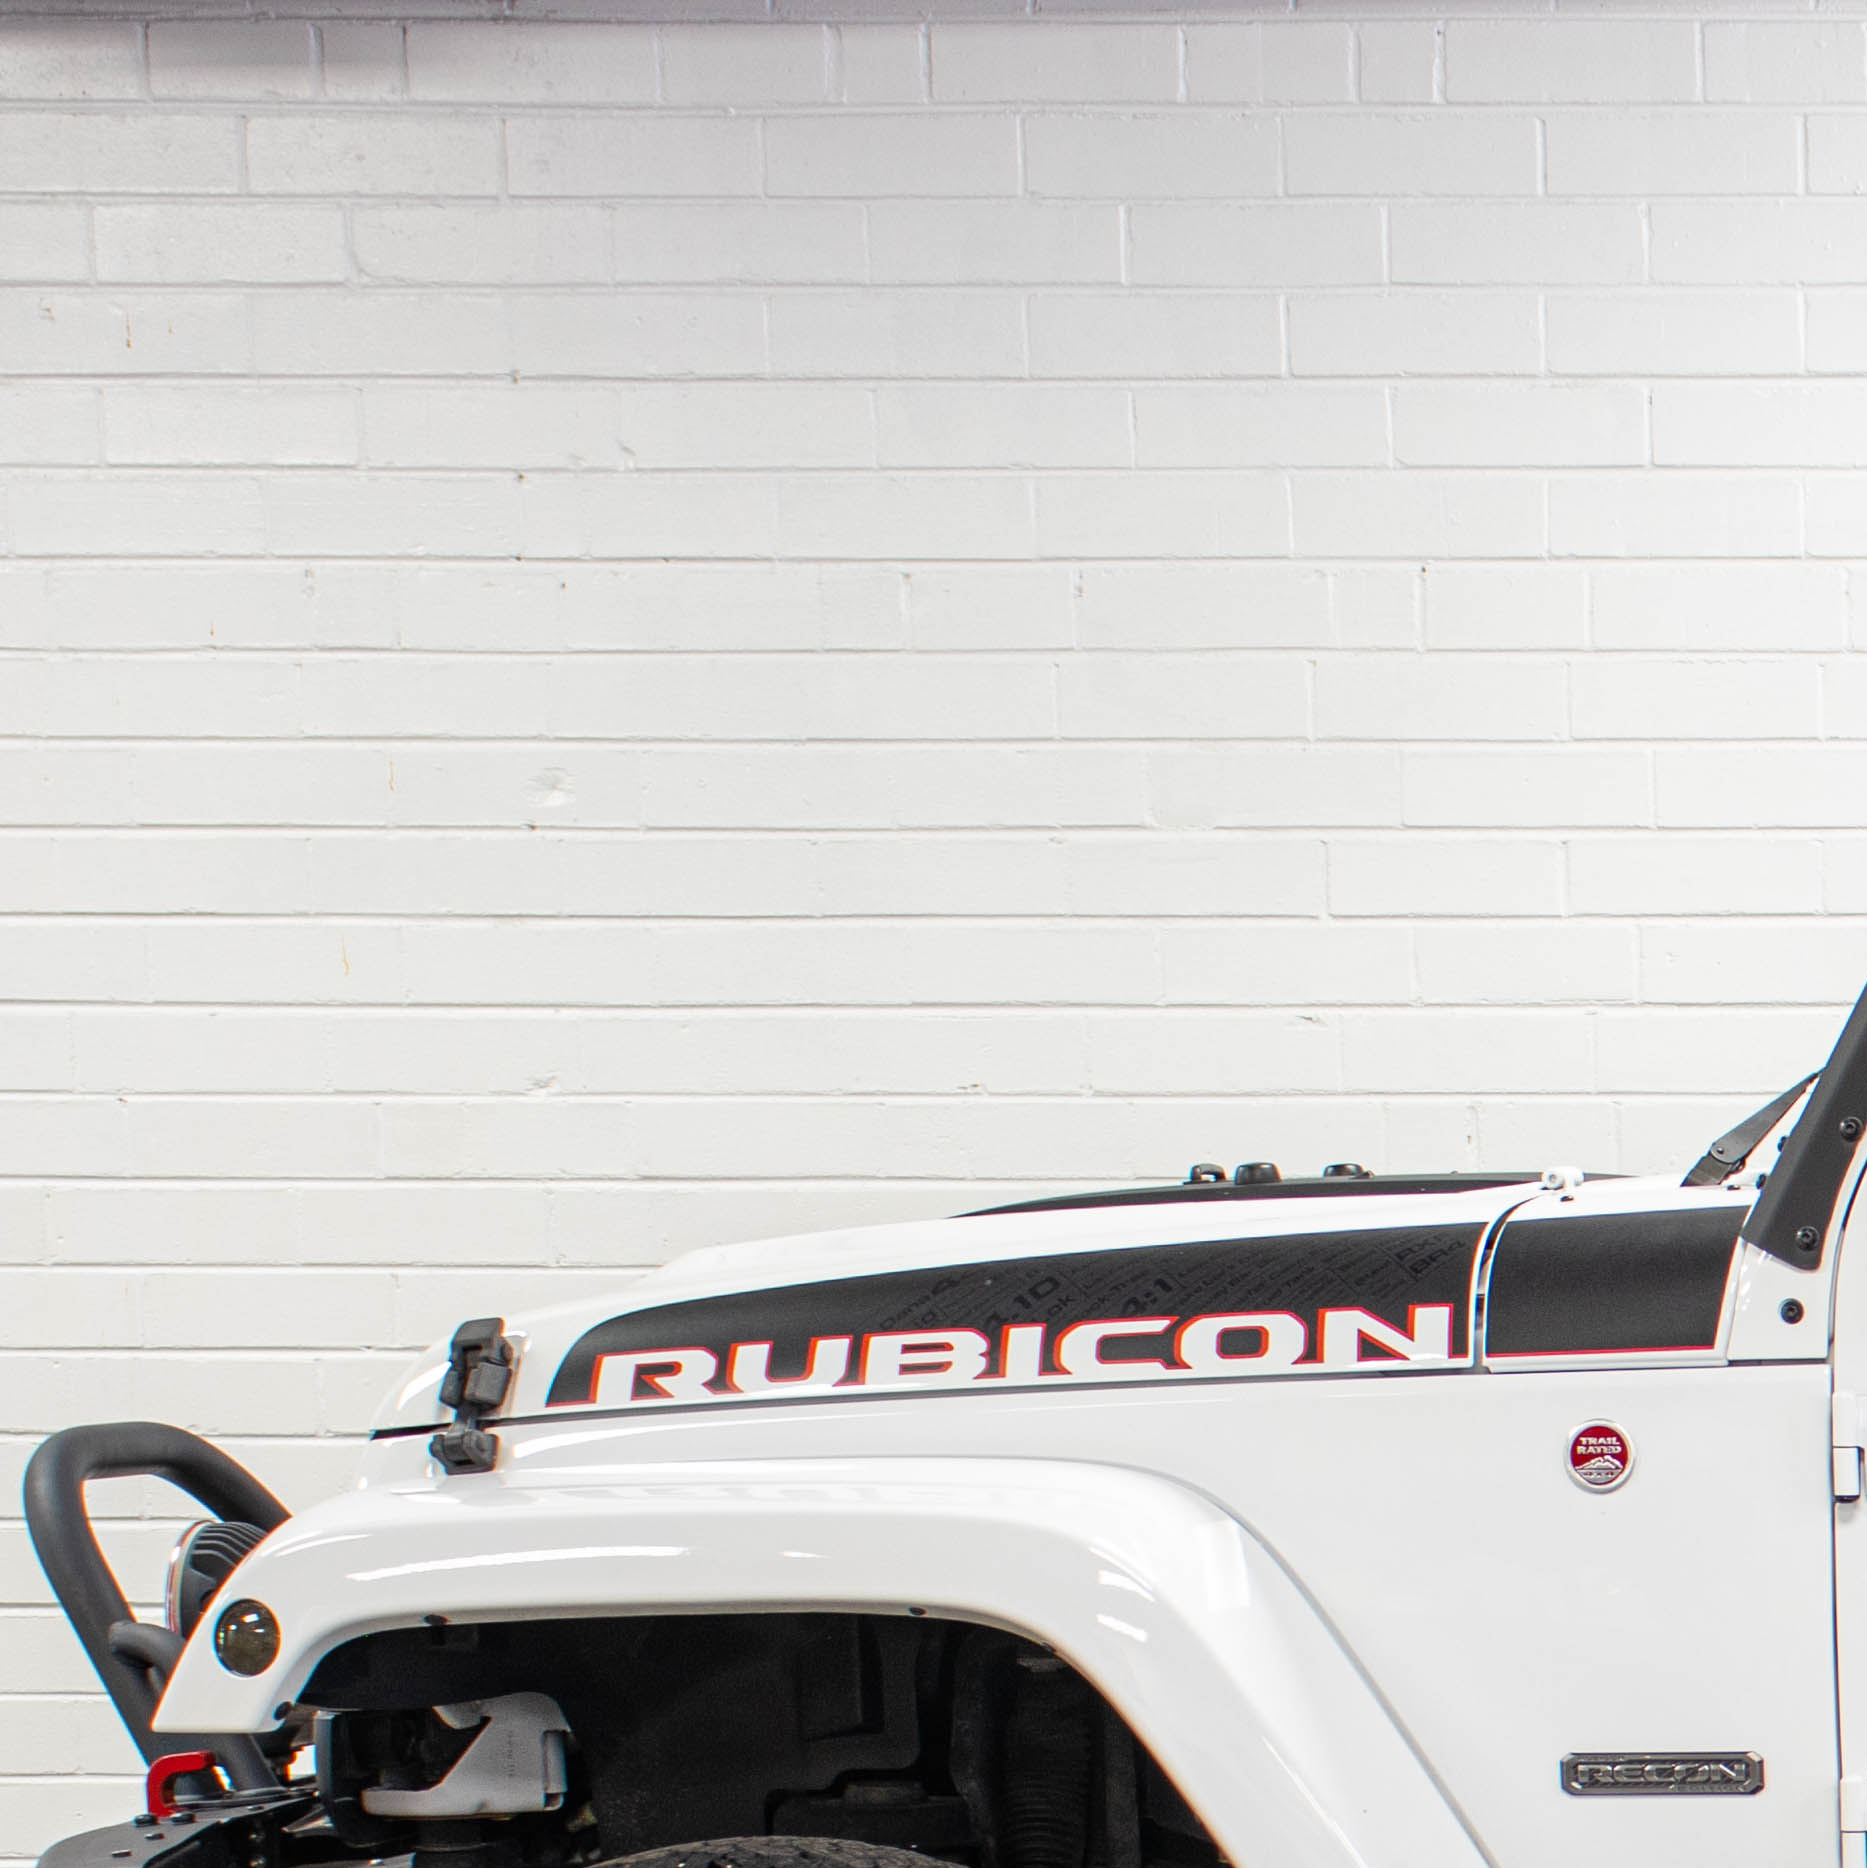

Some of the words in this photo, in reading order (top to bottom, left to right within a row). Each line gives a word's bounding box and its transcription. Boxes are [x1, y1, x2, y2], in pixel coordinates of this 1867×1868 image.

[589, 1303, 1455, 1404] RUBICON
[1578, 1436, 1621, 1446] TRAIL
[1576, 1446, 1622, 1455] RATED
[1576, 1762, 1747, 1783] RECON
